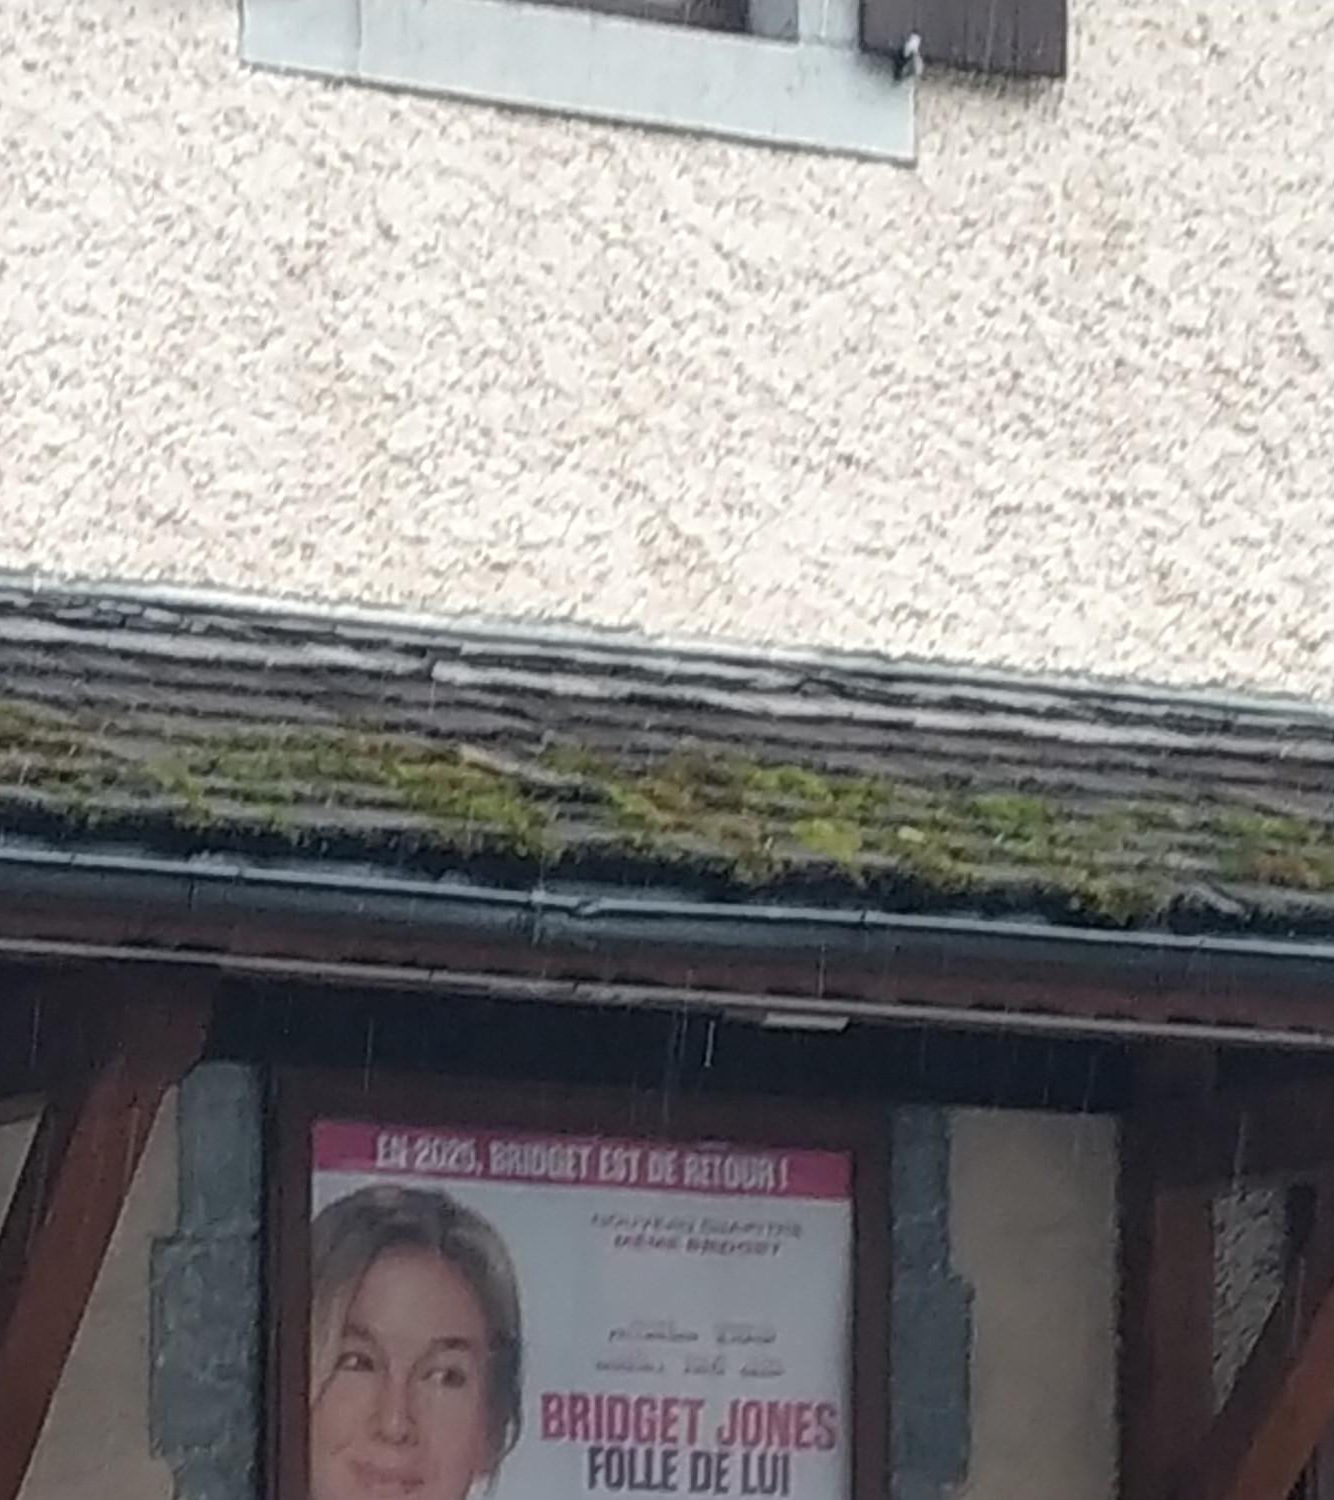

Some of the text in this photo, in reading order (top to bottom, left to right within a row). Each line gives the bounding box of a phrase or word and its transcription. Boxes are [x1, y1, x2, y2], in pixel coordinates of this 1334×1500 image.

[375, 1132, 409, 1164] EN
[488, 1140, 592, 1180] BRIDGET
[598, 1146, 641, 1182] EST
[649, 1148, 679, 1187] DE
[683, 1149, 775, 1191] RETOUR
[539, 1392, 838, 1451] BRIDGET JONES
[587, 1446, 791, 1498] FOLLE DE LUI
